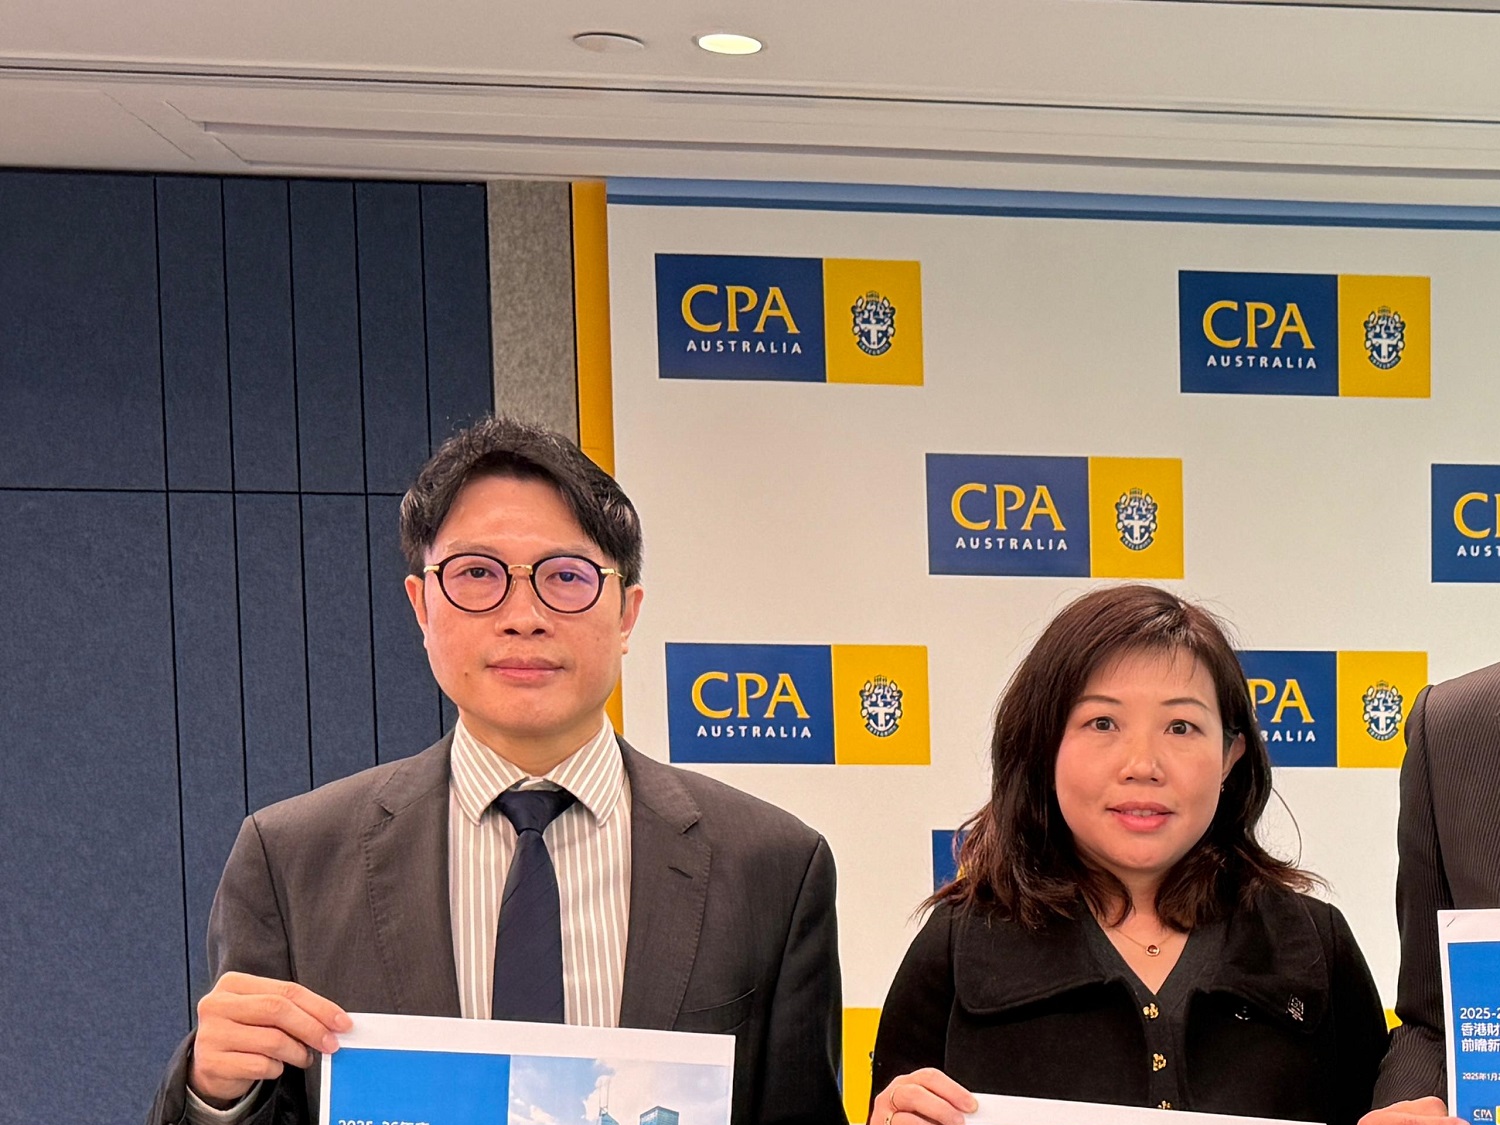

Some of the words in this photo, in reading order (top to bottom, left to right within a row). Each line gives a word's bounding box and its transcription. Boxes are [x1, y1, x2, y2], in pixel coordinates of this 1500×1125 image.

[682, 284, 799, 334] CPA
[1203, 300, 1315, 349] CPA
[687, 339, 802, 354] AUSTRALIA
[1207, 355, 1316, 369] AUSTRALIA
[951, 482, 1066, 532] CPA
[956, 536, 1068, 551] AUSTRALIA
[691, 671, 809, 719] CPA
[1247, 678, 1315, 723] PA
[696, 725, 812, 738] AUSTRALIA
[1261, 730, 1316, 742] RALIA
